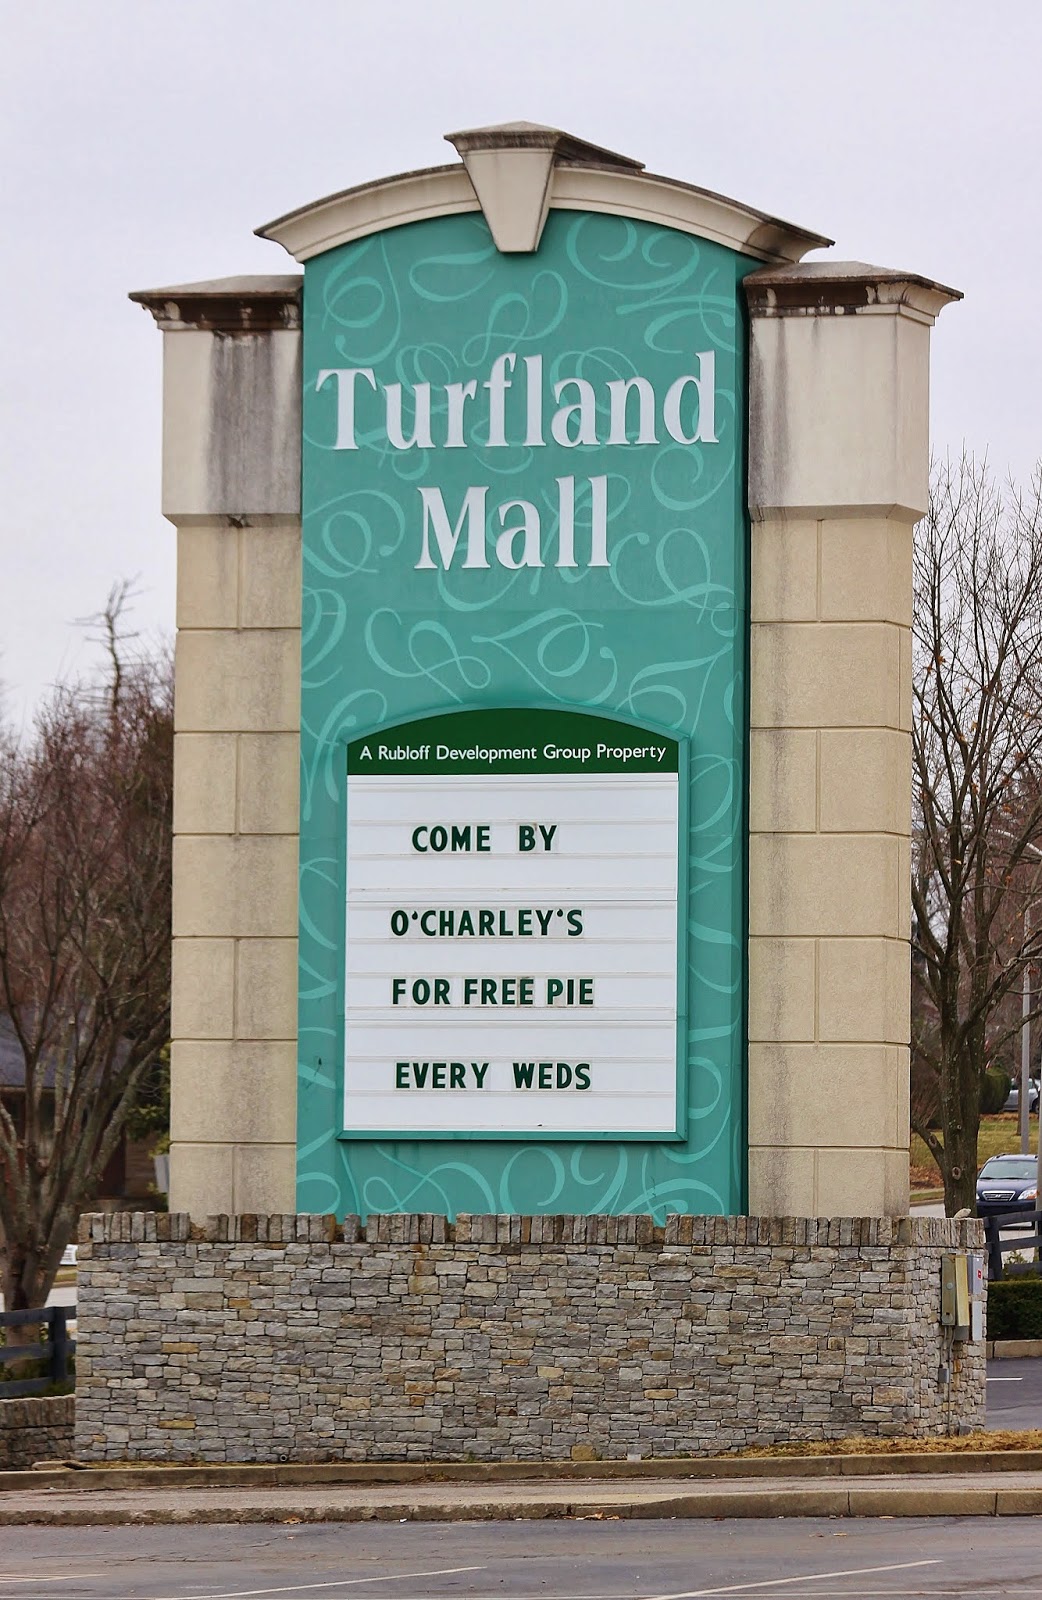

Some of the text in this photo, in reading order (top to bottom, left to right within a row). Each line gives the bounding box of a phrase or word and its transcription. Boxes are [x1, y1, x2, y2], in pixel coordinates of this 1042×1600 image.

[316, 350, 719, 450] Turfland
[414, 475, 611, 571] Mall
[360, 743, 667, 763] A Rubloff Development Group Property
[411, 825, 557, 852] COME BY
[390, 909, 584, 937] O'CHARLEY'S
[392, 978, 594, 1005] FOR FREE PIE
[395, 1062, 591, 1090] EVERY WEDS
